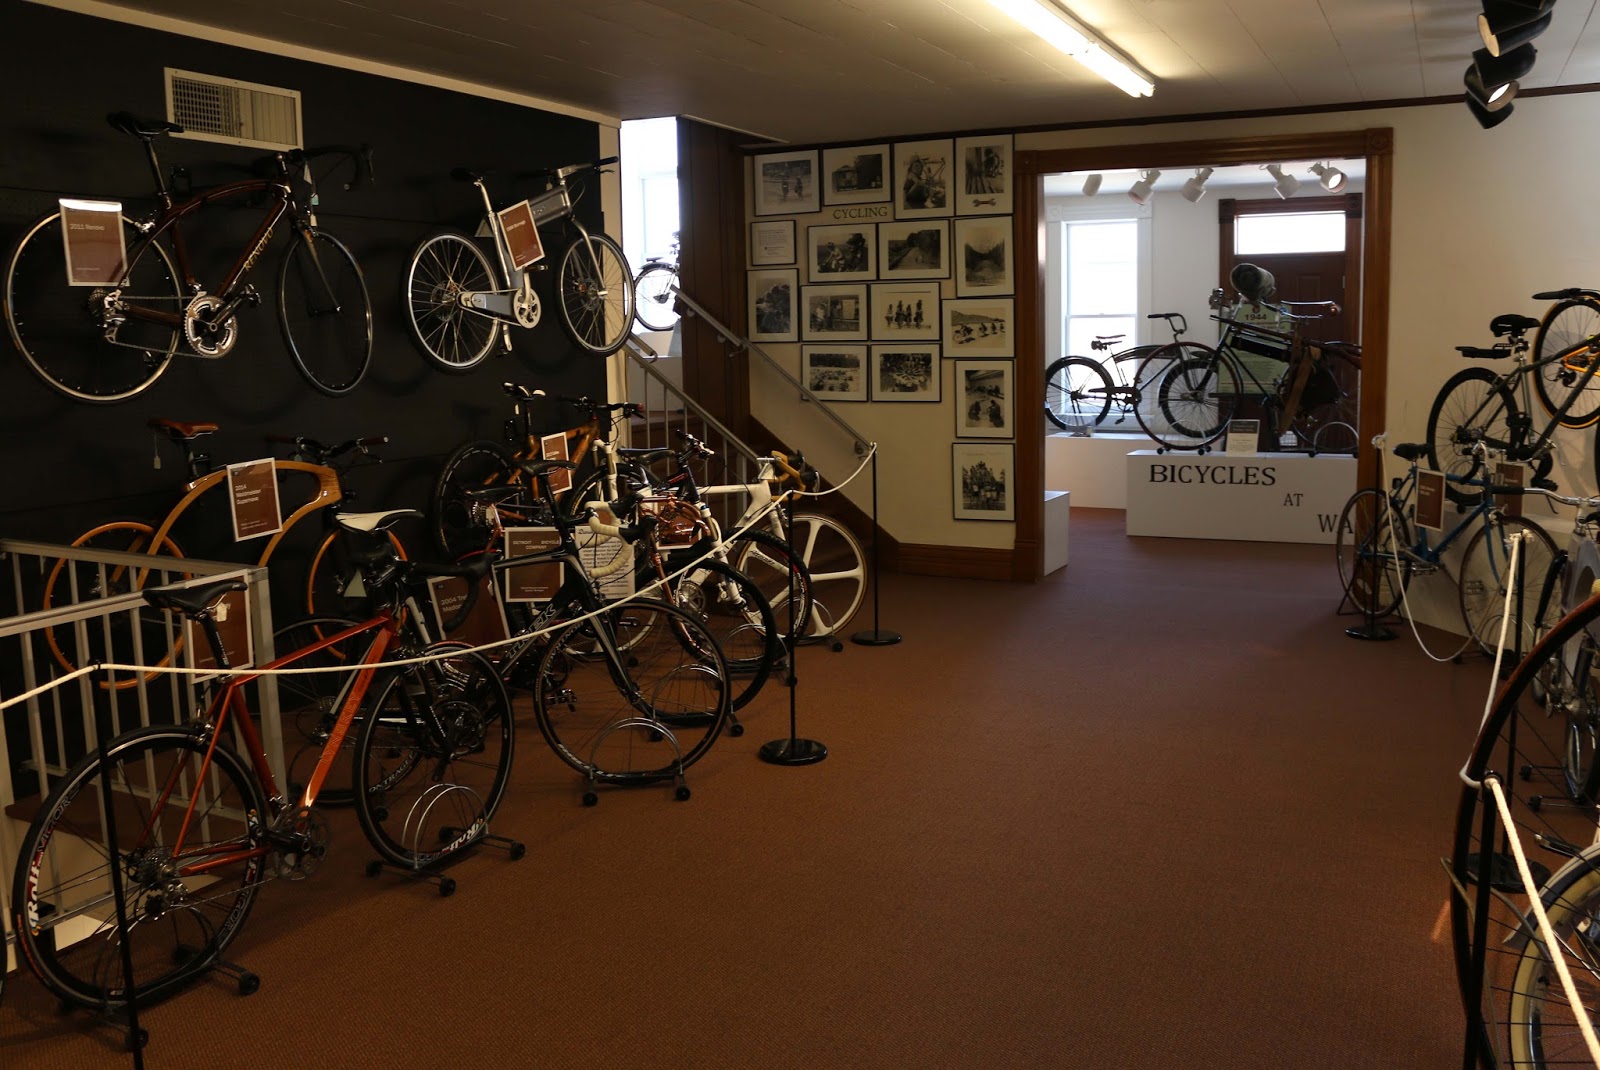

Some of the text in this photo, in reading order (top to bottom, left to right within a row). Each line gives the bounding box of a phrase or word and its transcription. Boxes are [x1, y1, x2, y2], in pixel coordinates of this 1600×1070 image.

[833, 207, 888, 219] CYCLING
[244, 227, 273, 271] RENOVO
[1245, 313, 1267, 321] 1944
[1150, 464, 1276, 486] BICYCLES
[1283, 493, 1304, 507] AT
[1317, 514, 1354, 534] WA
[441, 597, 457, 606] 2004
